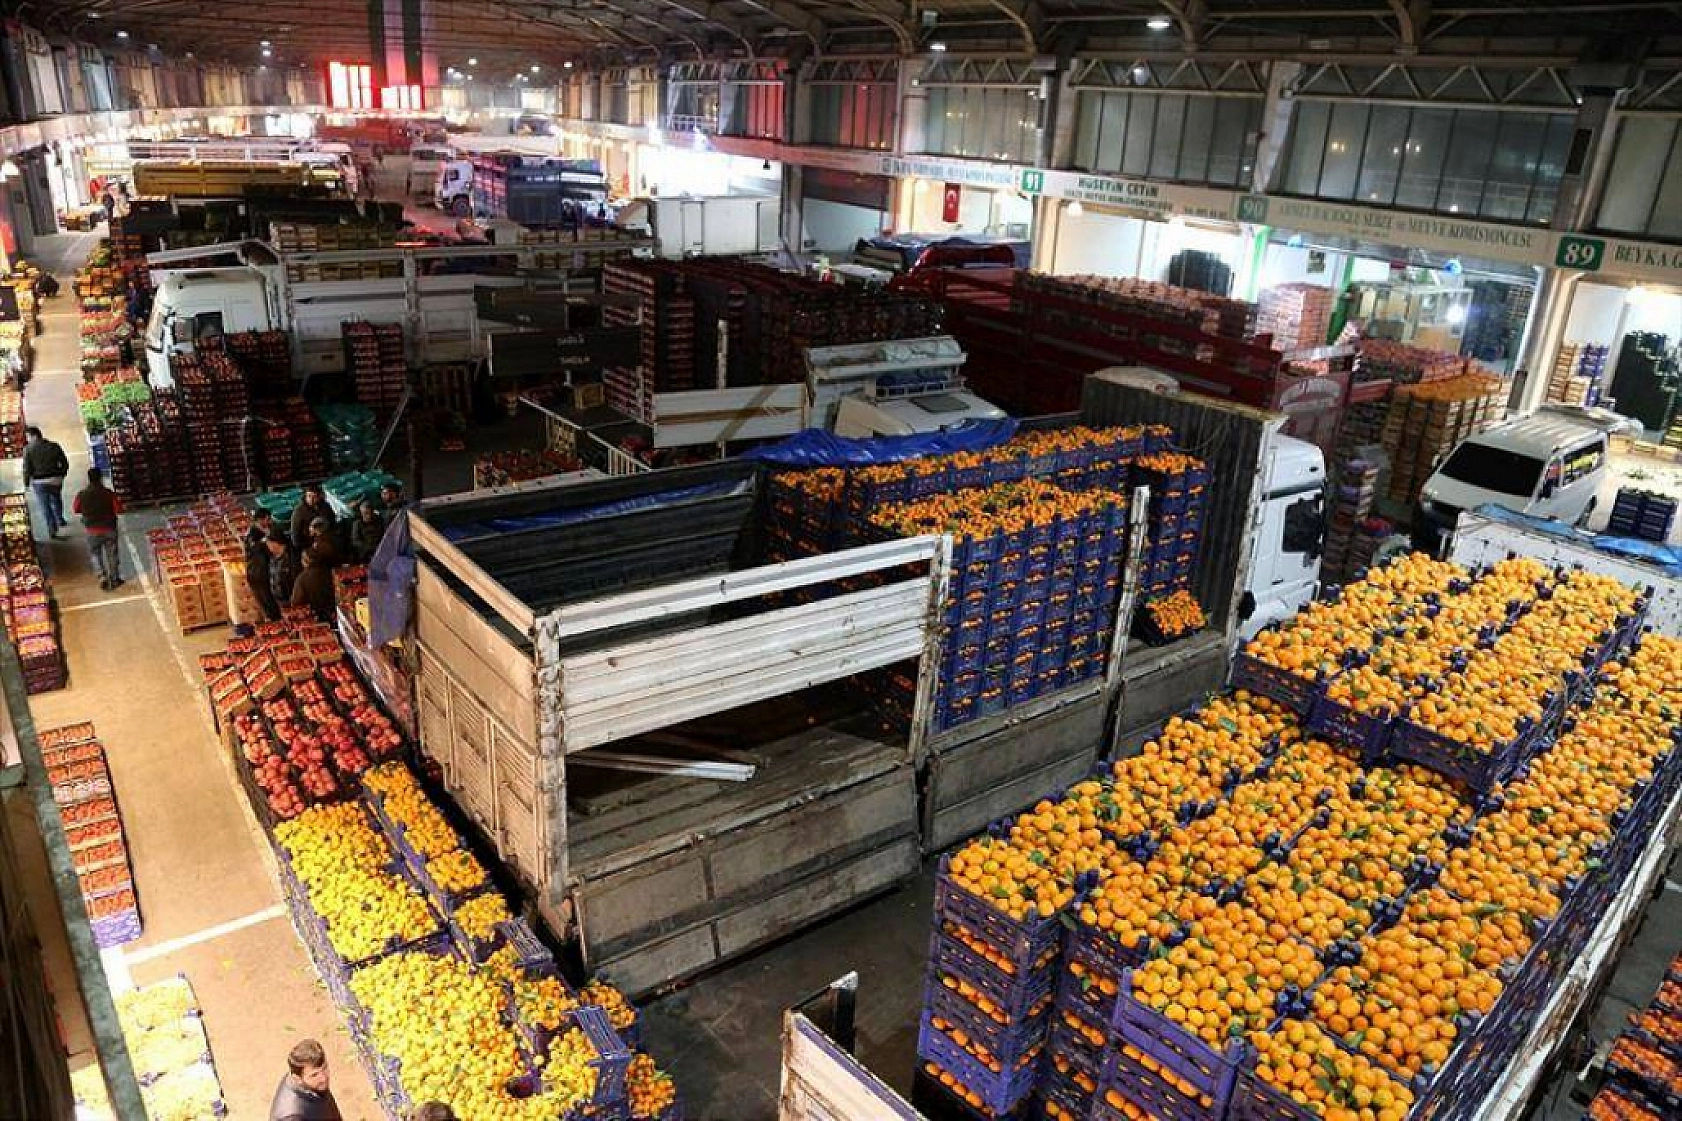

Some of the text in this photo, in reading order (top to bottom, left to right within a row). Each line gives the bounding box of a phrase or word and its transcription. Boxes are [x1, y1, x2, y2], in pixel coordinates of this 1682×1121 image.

[1026, 171, 1041, 191] 91
[1243, 201, 1263, 218] 90
[1565, 242, 1595, 266] 89
[1614, 244, 1668, 267] BEYKA
